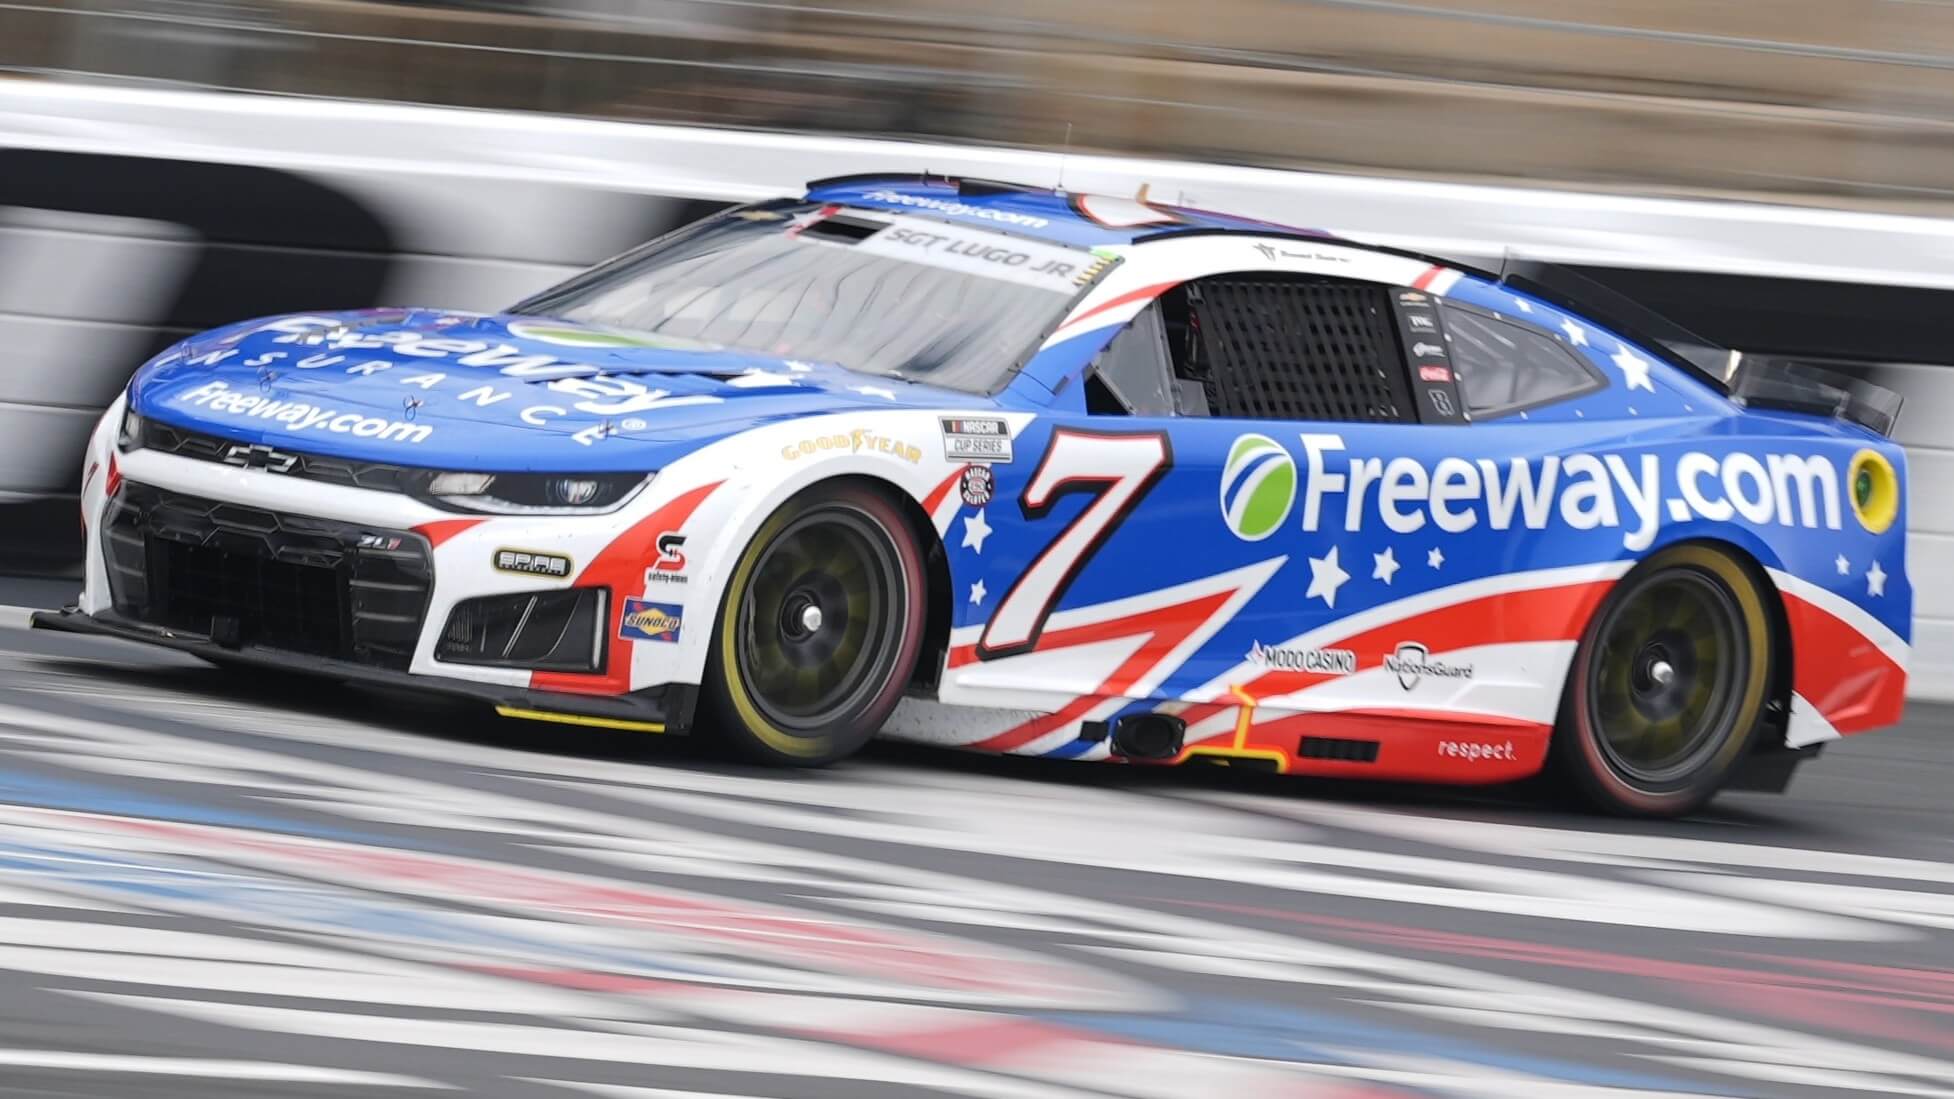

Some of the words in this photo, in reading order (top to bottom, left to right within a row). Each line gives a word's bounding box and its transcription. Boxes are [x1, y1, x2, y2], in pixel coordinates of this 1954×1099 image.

[863, 191, 1049, 229] Freeway.com
[885, 228, 950, 248] SGT
[942, 238, 1029, 267] LUGO
[1031, 258, 1077, 279] JR
[179, 380, 434, 443] Freeway.com
[963, 419, 999, 435] NASCAR
[782, 428, 922, 464] GOODYEAR
[954, 438, 972, 451] CUP
[972, 439, 1002, 453] SERIES
[1301, 433, 1842, 550] Freeway.com
[978, 428, 1172, 658] 7
[626, 612, 681, 633] SUNOCO
[1264, 648, 1304, 670] MODO
[1306, 650, 1353, 673] CASINO
[1438, 740, 1517, 762] respect.
